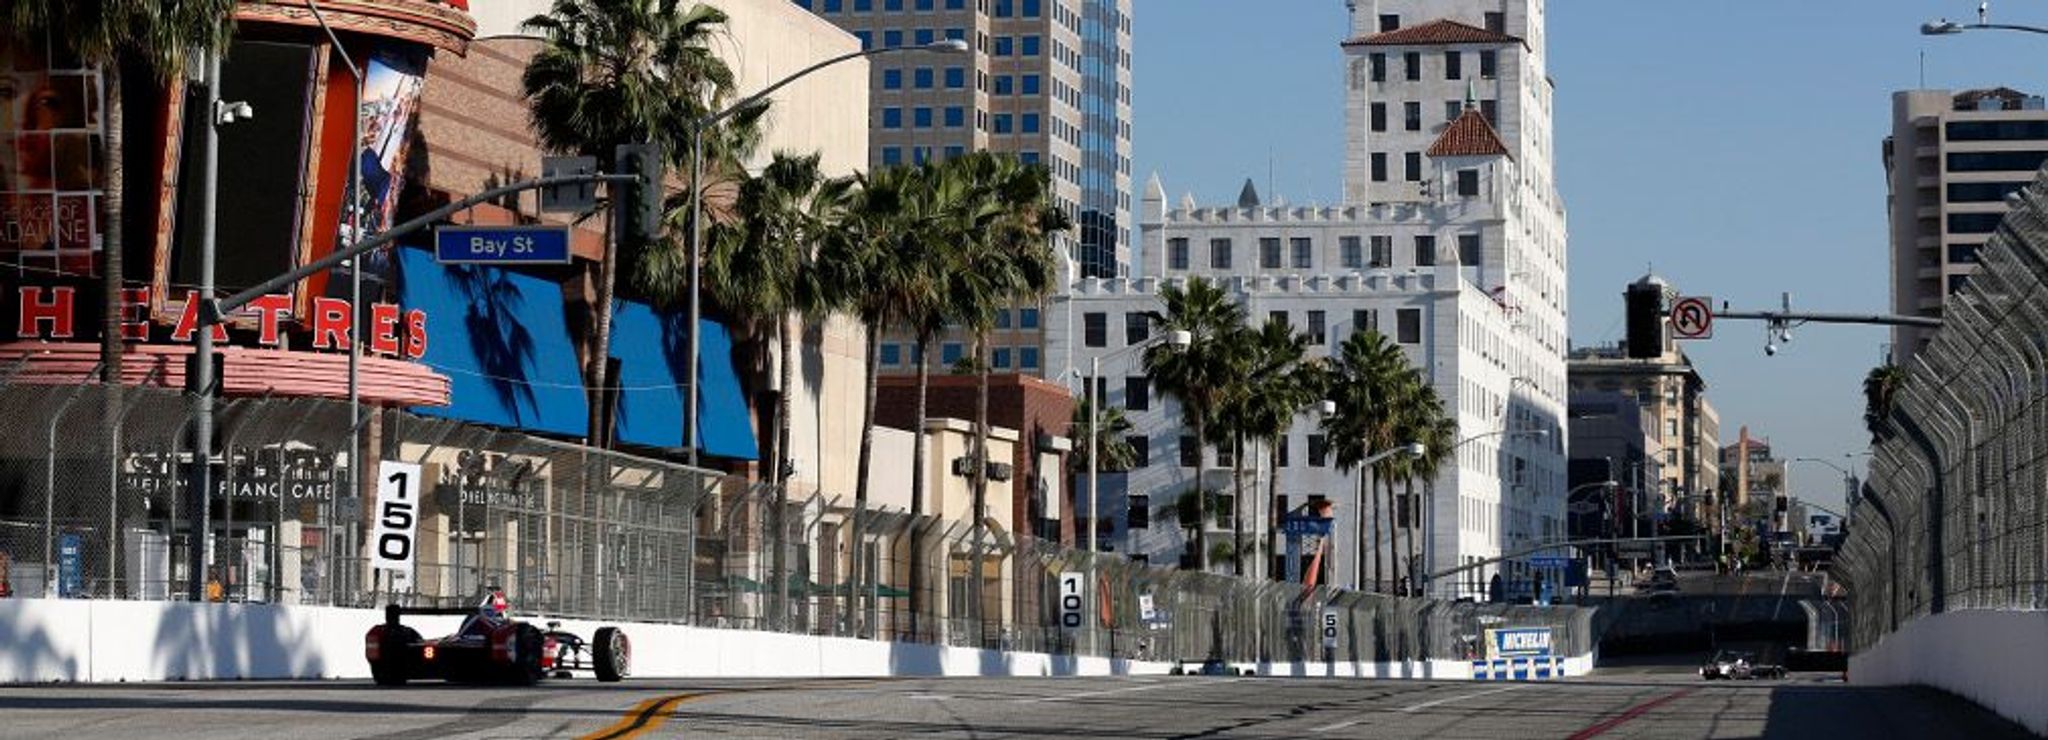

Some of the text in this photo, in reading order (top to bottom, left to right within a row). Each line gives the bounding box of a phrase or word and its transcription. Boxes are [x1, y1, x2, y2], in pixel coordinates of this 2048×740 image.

[470, 237, 534, 257] Bay St
[291, 483, 332, 500] CAFÉ
[379, 472, 412, 561] 150
[1063, 578, 1082, 627] 100
[1324, 614, 1337, 638] 50
